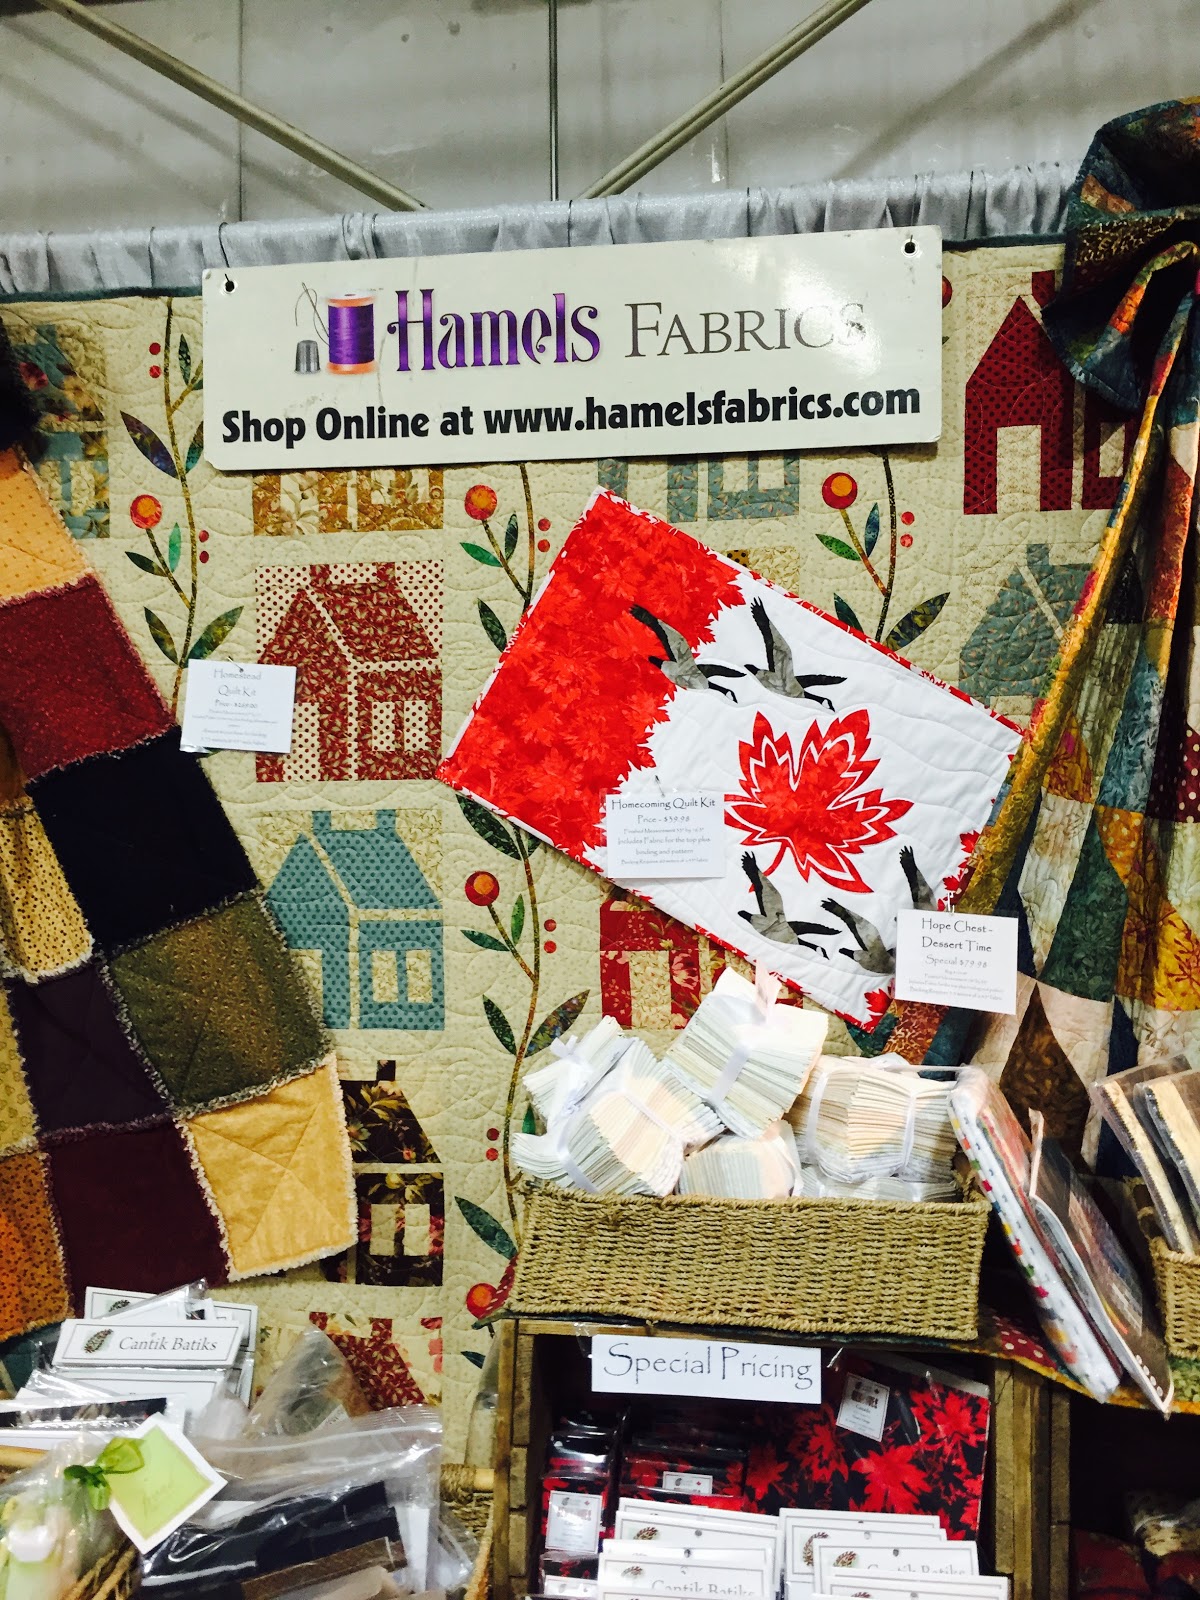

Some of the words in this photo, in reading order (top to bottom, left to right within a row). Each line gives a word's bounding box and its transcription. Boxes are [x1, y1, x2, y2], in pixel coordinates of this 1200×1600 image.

[387, 288, 600, 372] Hamels
[624, 300, 866, 359] FABRICS
[221, 408, 306, 450] Shop
[315, 404, 430, 441] Online
[439, 404, 474, 436] at
[482, 386, 921, 434] www.hamelsfabrics.com
[213, 668, 262, 680] Homestead
[218, 684, 241, 697] Quilt
[242, 686, 257, 698] Kit
[611, 798, 672, 811] Homecoming
[672, 797, 699, 810] Quilt
[700, 796, 717, 809] Kit
[637, 814, 657, 825] Price
[921, 917, 952, 934] Hope
[953, 919, 987, 933] Chest
[922, 936, 963, 949] Dessert
[965, 940, 992, 952] Time
[925, 954, 958, 967] Special
[119, 1336, 168, 1351] Cantik
[172, 1337, 218, 1351] Batiks
[603, 1342, 712, 1384] Special
[720, 1346, 814, 1390] Pricing
